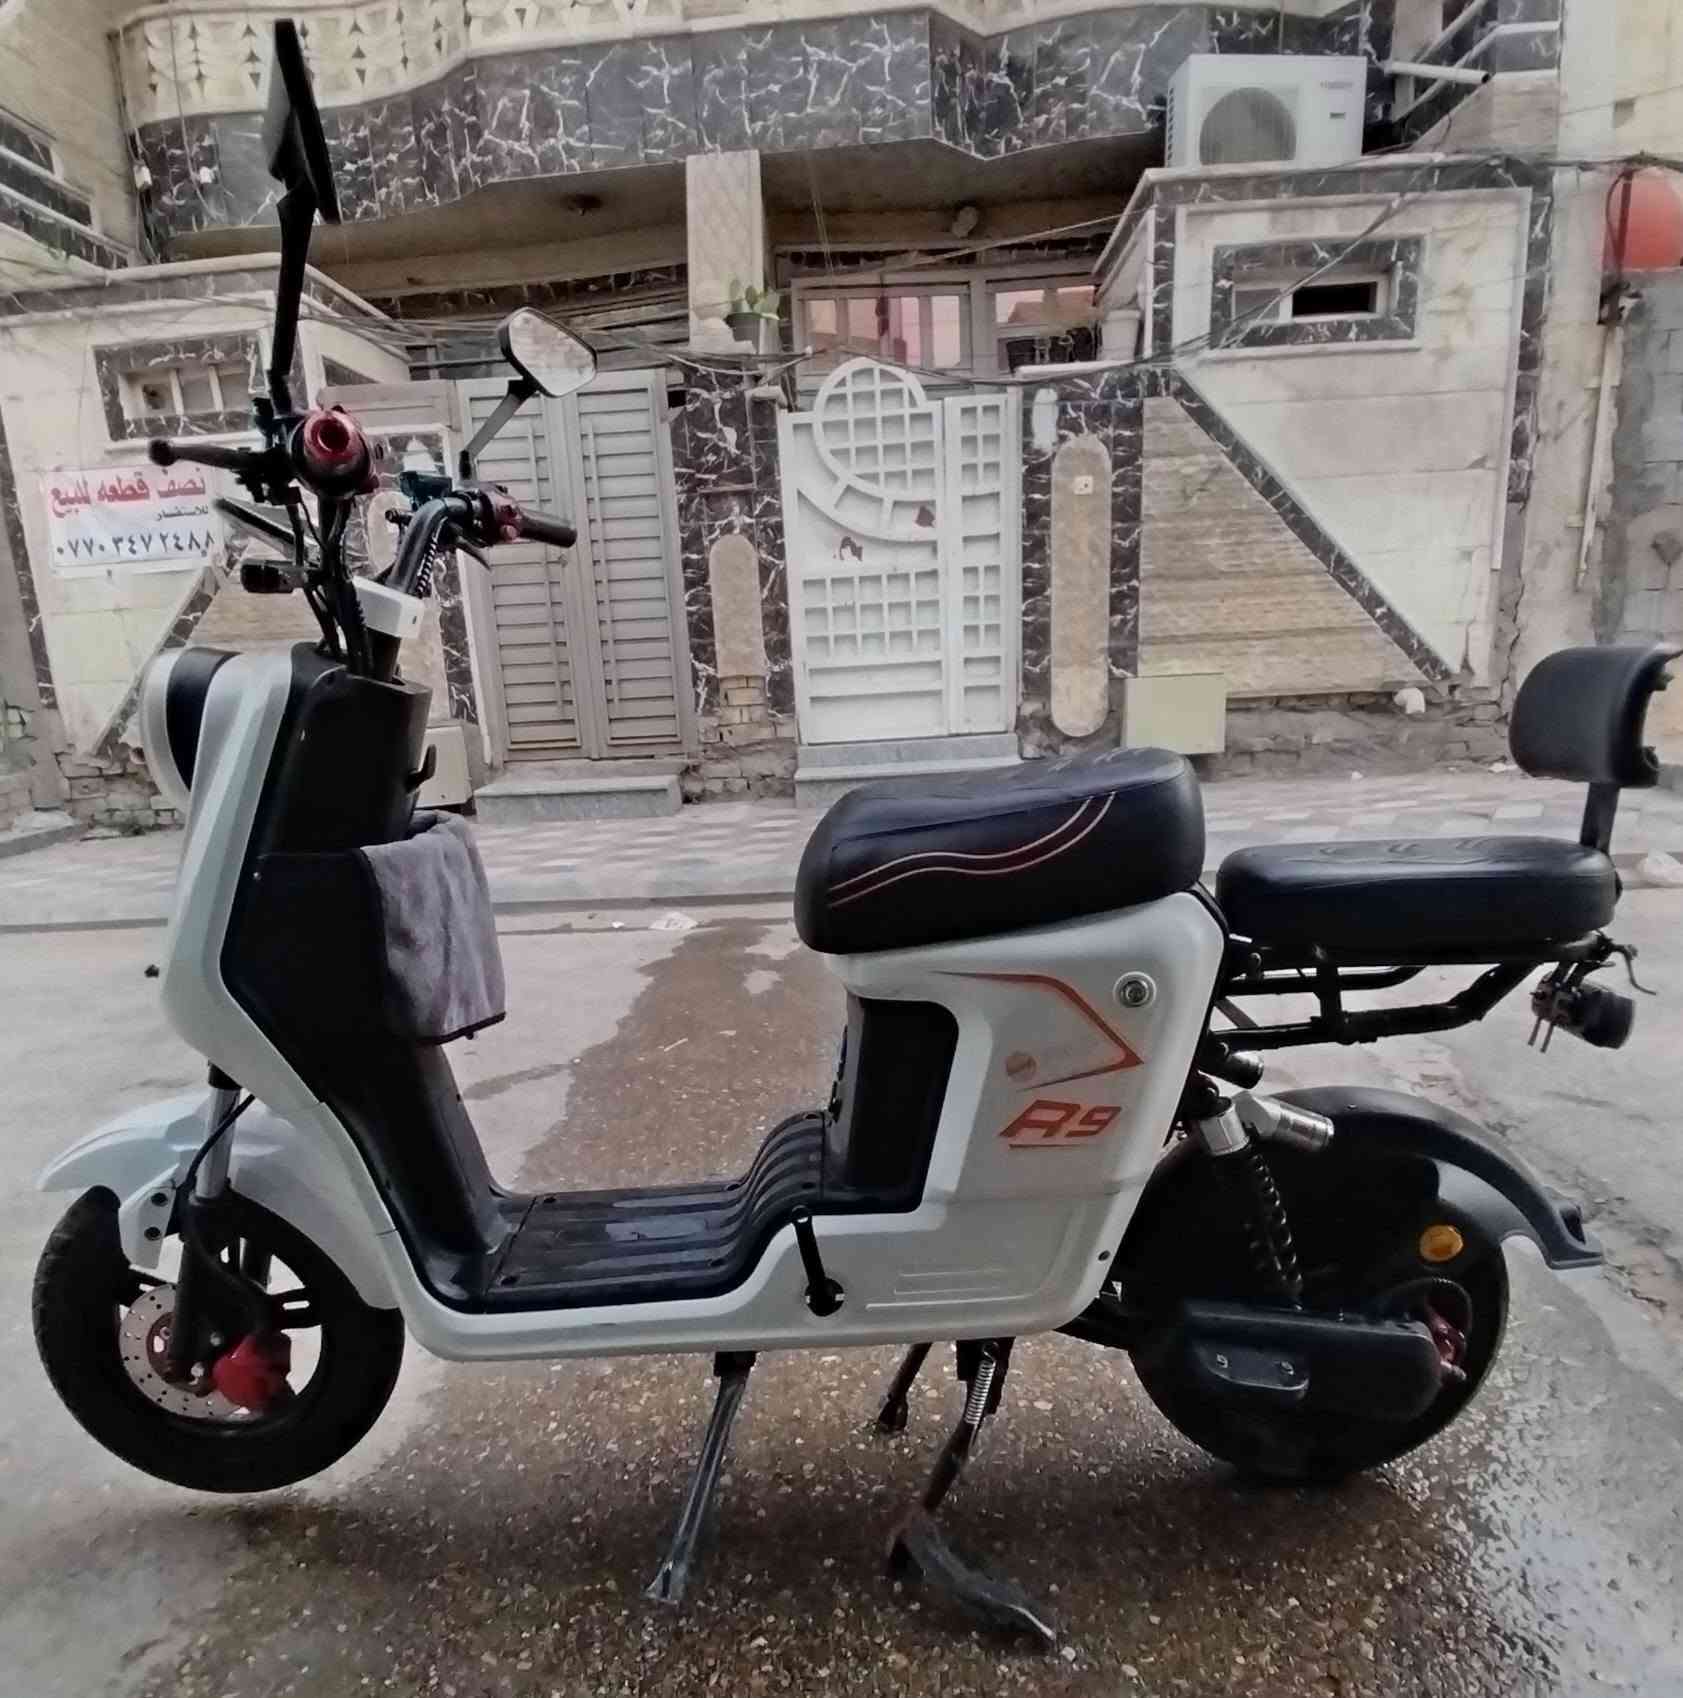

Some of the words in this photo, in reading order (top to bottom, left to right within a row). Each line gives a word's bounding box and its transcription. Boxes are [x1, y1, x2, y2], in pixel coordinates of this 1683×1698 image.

[50, 475, 91, 518] للبيع
[156, 468, 206, 498] نصف
[999, 1099, 1122, 1138] R9
